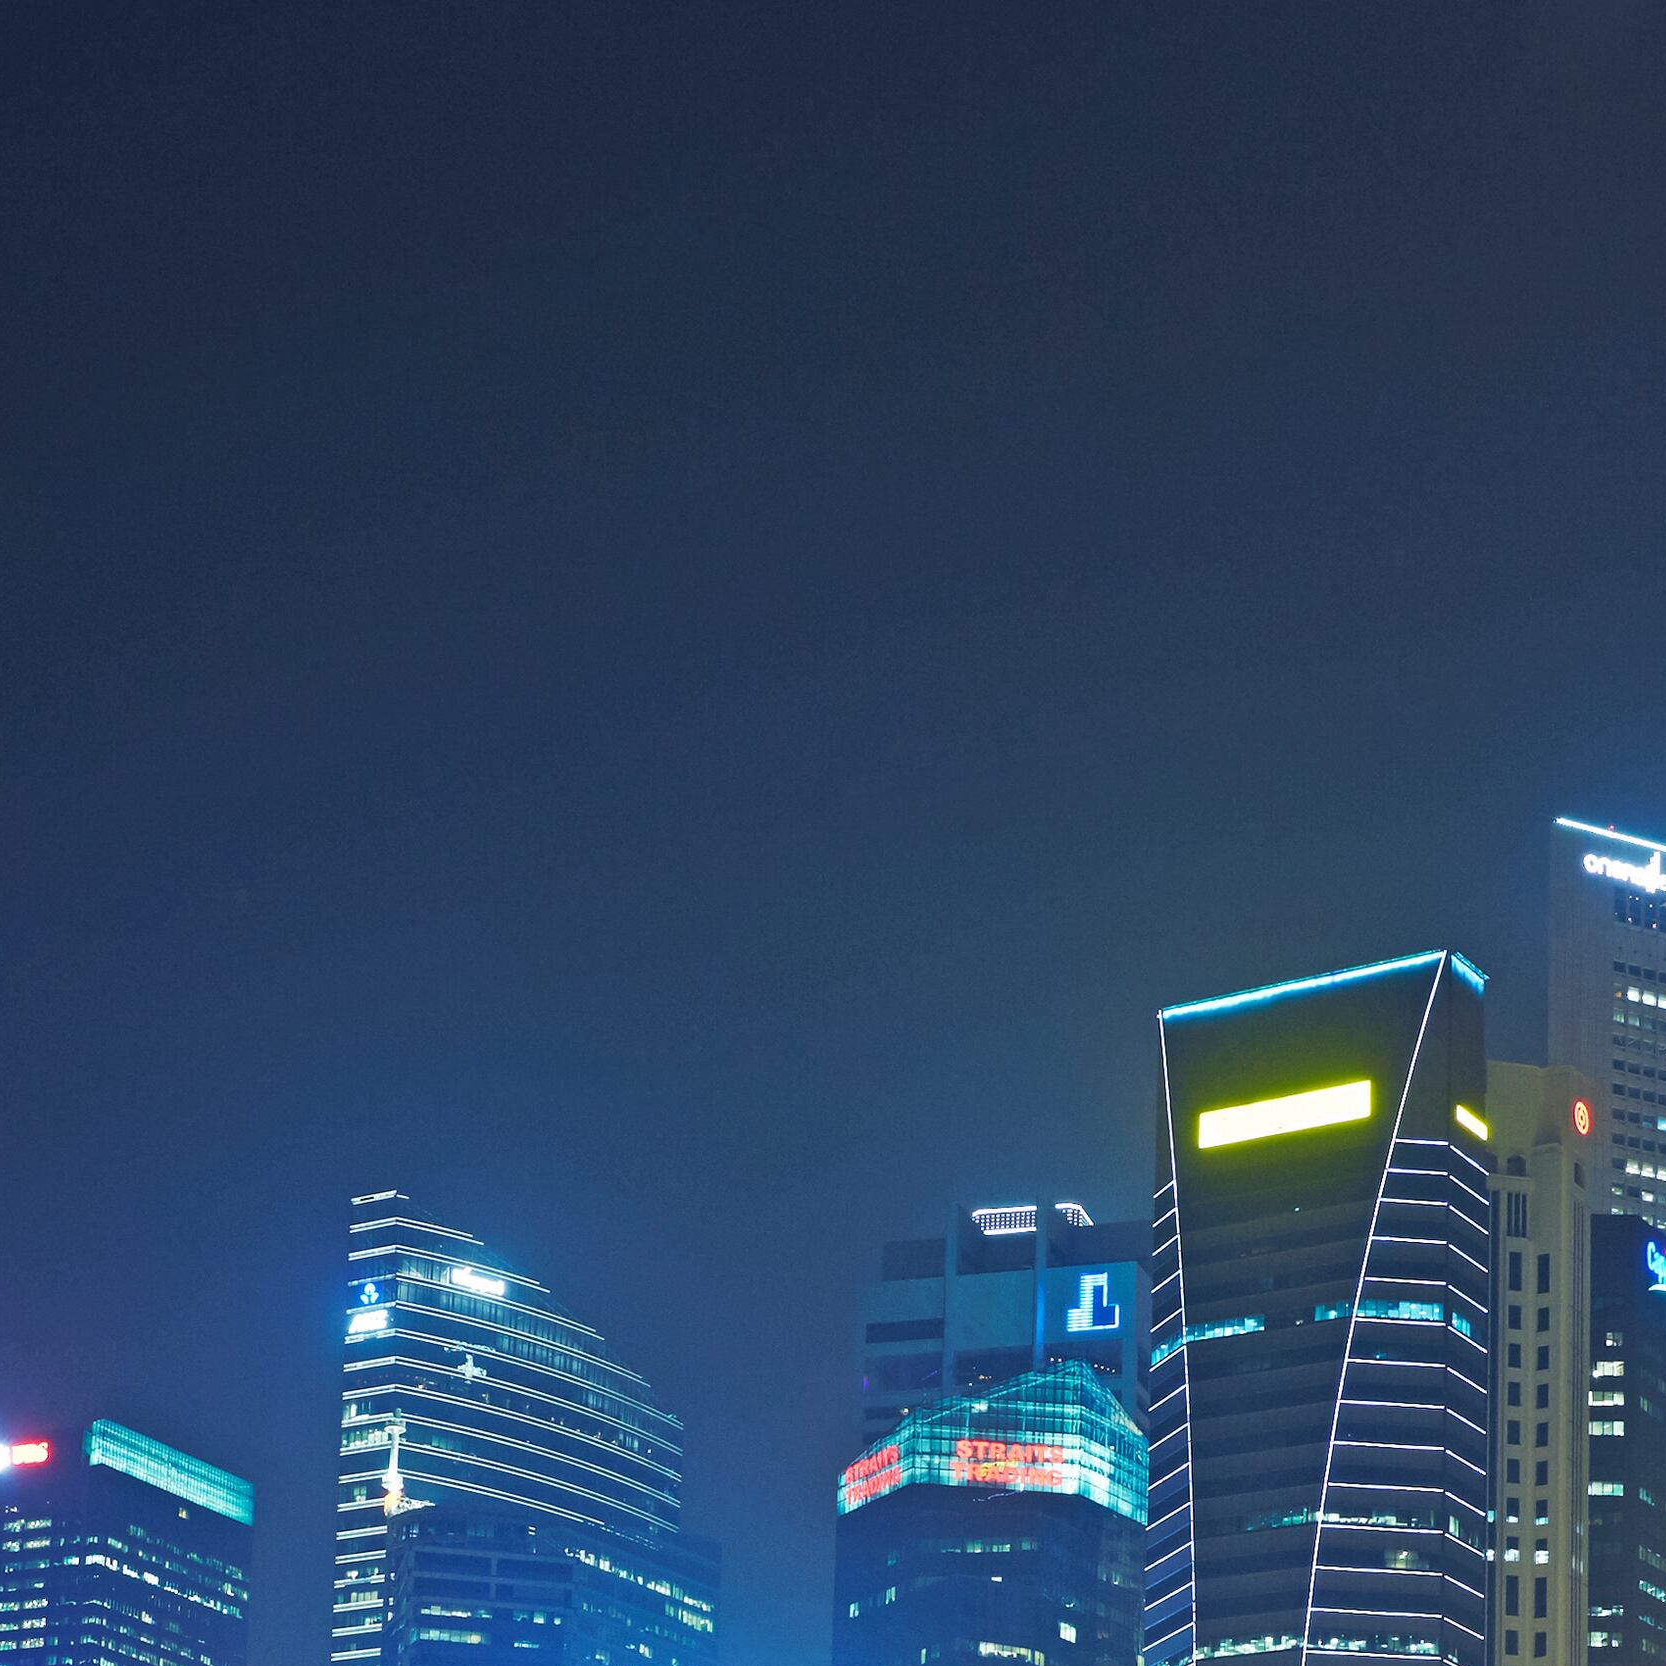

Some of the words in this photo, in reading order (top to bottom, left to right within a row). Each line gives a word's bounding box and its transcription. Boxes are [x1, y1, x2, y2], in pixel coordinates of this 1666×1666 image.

[844, 1445, 900, 1485] STRAITS
[956, 1439, 1064, 1463] STRAITS
[844, 1465, 901, 1505] TRADING
[949, 1461, 1063, 1487] TRADING
